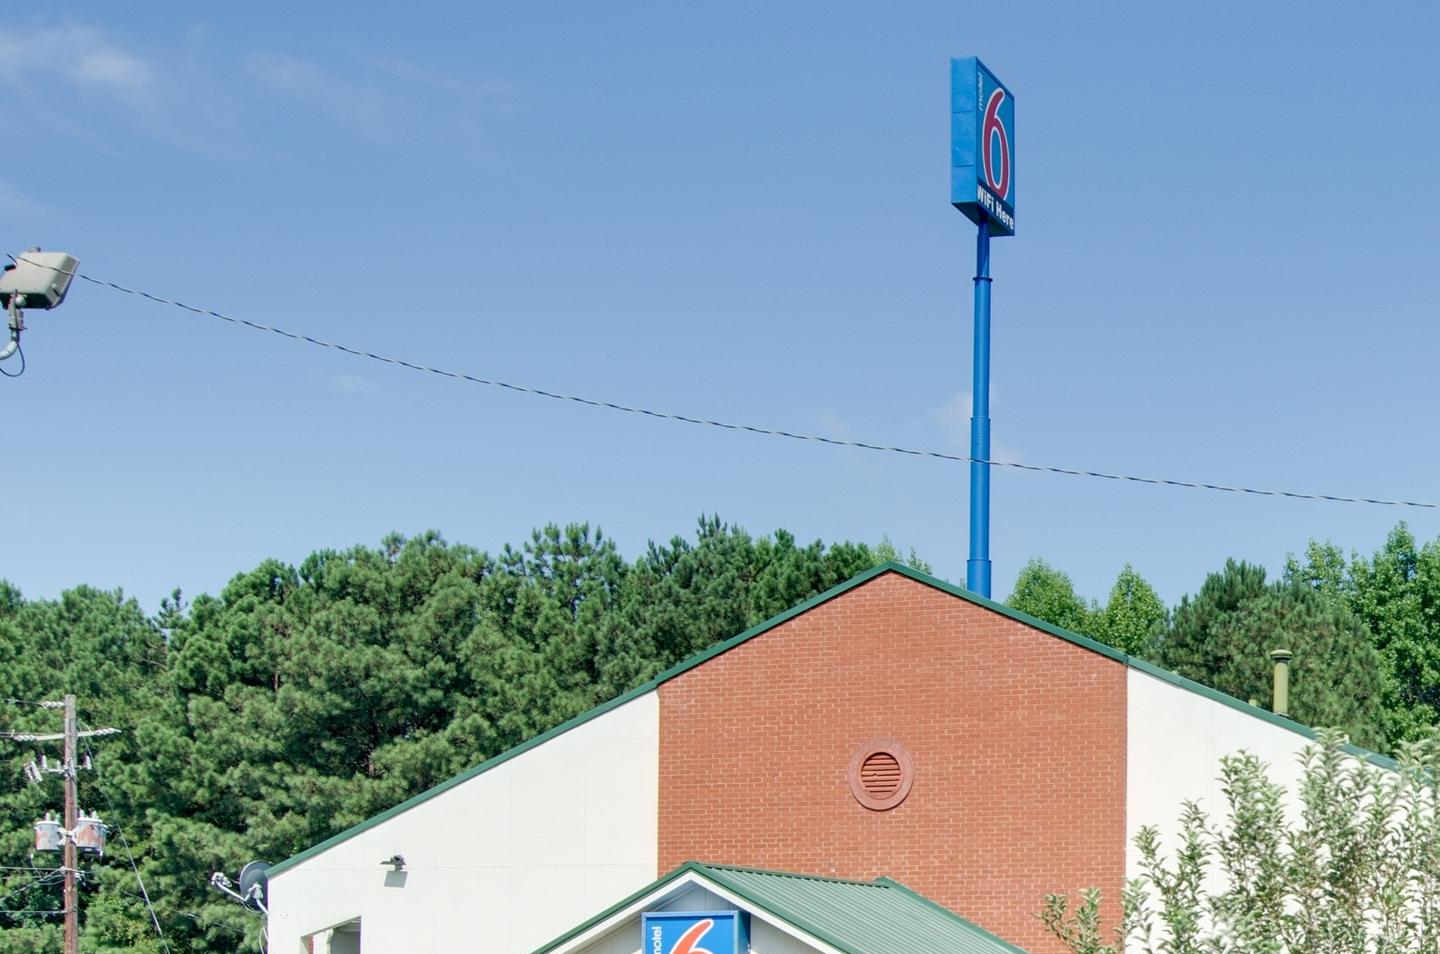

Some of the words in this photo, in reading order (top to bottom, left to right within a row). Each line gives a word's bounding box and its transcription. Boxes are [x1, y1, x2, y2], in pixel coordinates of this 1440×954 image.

[983, 87, 1010, 201] 6
[977, 185, 994, 213] WiFi
[996, 205, 1014, 230] Here
